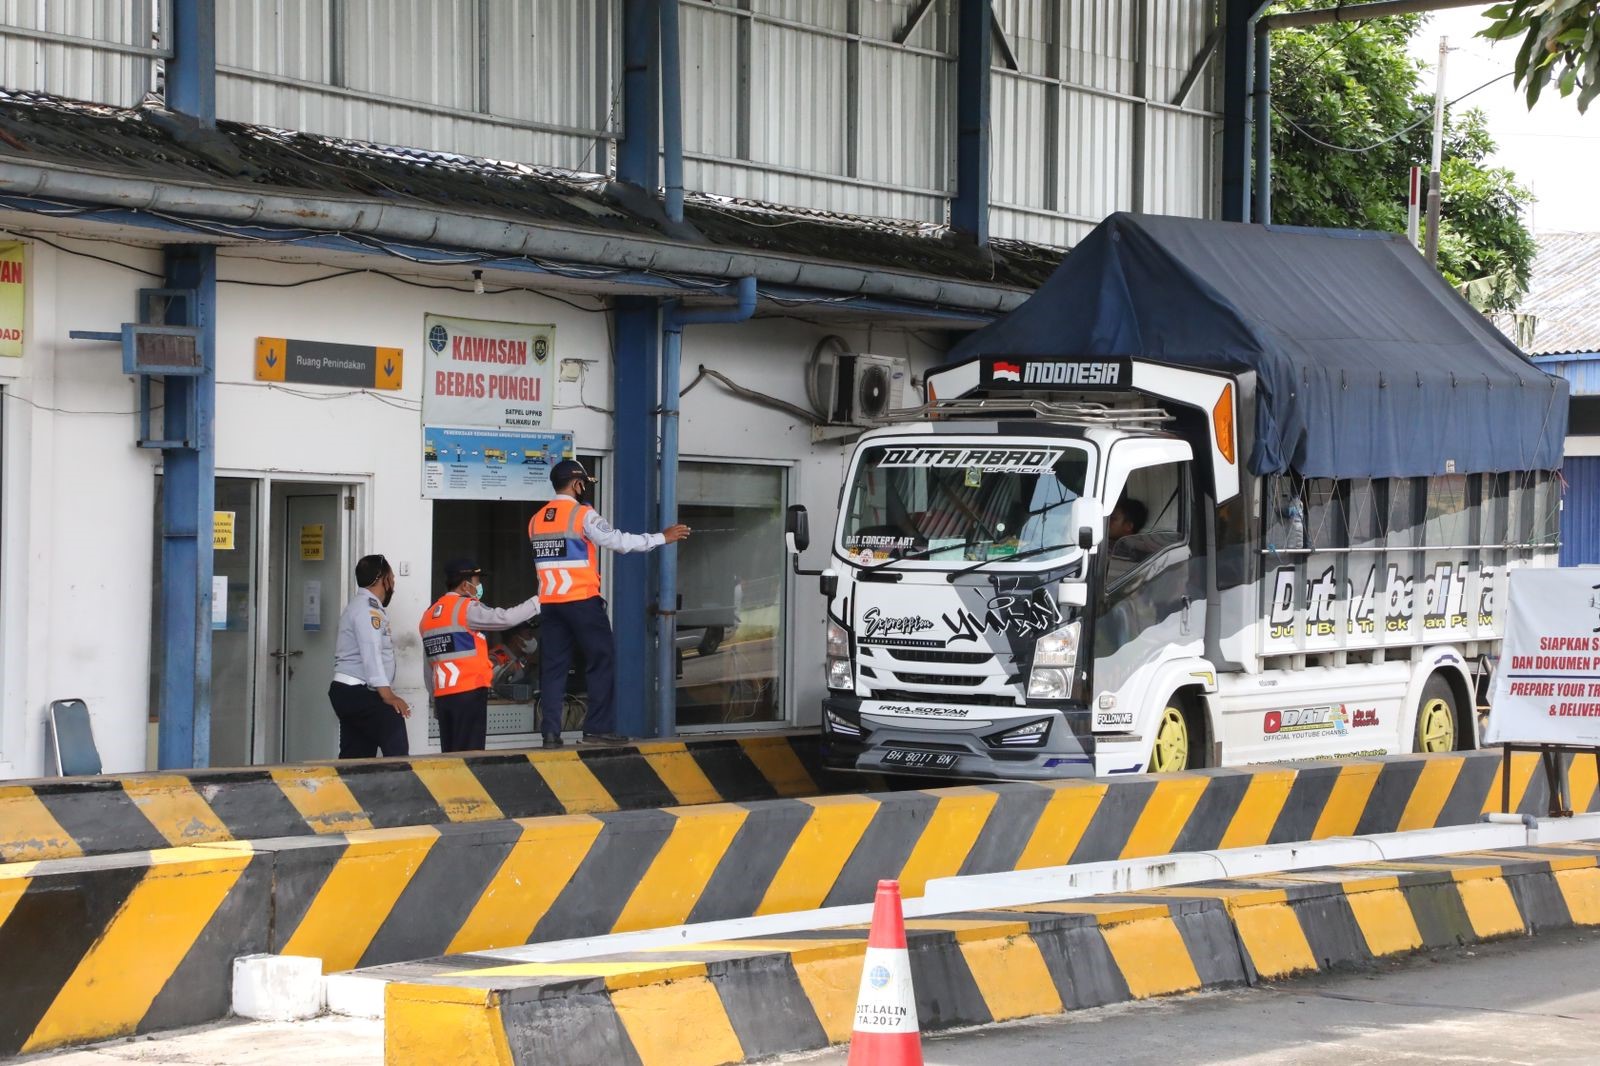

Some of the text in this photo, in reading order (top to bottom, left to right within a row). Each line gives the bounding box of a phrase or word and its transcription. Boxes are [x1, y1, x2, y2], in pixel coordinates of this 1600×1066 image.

[0, 261, 22, 284] AN
[452, 335, 527, 365] KAWASAN
[296, 355, 366, 370] Ruang Penindakan
[435, 370, 541, 402] BEBAS PUNGLI
[879, 448, 1063, 467] DUTA ABADI
[984, 466, 1056, 474] OFFICIAL
[846, 535, 860, 545] DAT
[861, 535, 895, 545] CONCEPT
[536, 548, 560, 557] DARAT
[1540, 637, 1589, 651] SIAPKAN
[1512, 655, 1533, 669] DAN
[1536, 656, 1590, 670] DOKUMEN
[1510, 682, 1555, 696] PREPARE
[1557, 683, 1585, 697] YOUR
[1280, 707, 1330, 727] DAT
[1549, 704, 1557, 716] &
[1097, 713, 1132, 724] FOLLOW ME
[1292, 731, 1320, 739] YOUTUBE
[1321, 729, 1349, 737] CHANNEL
[886, 750, 954, 764] BH 8011 BN
[858, 1016, 901, 1026] TA.2017
